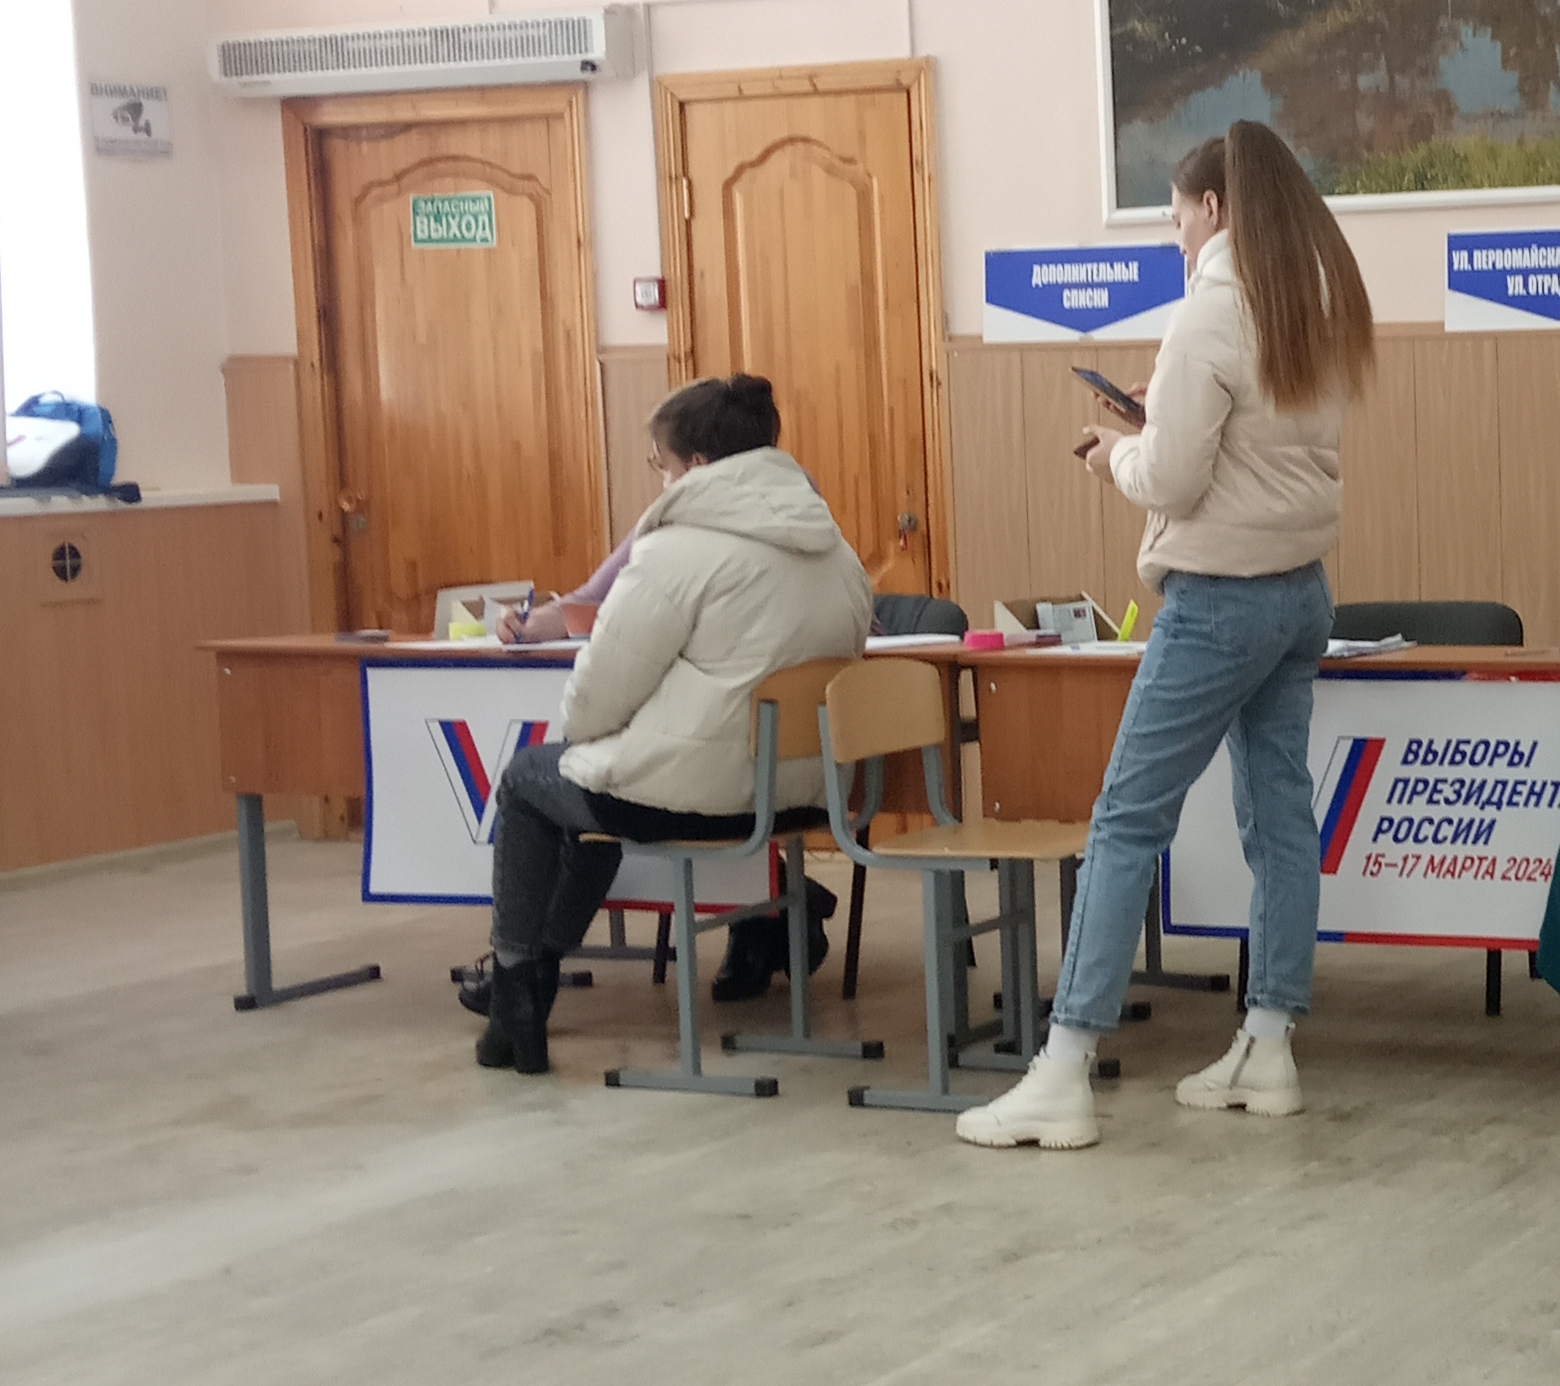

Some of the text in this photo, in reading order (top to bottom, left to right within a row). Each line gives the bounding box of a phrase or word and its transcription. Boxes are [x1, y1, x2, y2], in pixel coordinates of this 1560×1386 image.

[416, 214, 494, 244] ВЫХОД
[1031, 261, 1140, 288] ДОПОЛНИТЕЛЬНЫЕ
[1452, 250, 1472, 272] УЛ.
[1062, 287, 1109, 310] СПИСКИ
[1507, 275, 1527, 297] УЛ.
[1401, 738, 1539, 768] ВЫБОРЫ
[1372, 816, 1497, 846] РОССИИ
[1423, 854, 1497, 881] МАРТА
[1500, 856, 1554, 883] 2024
